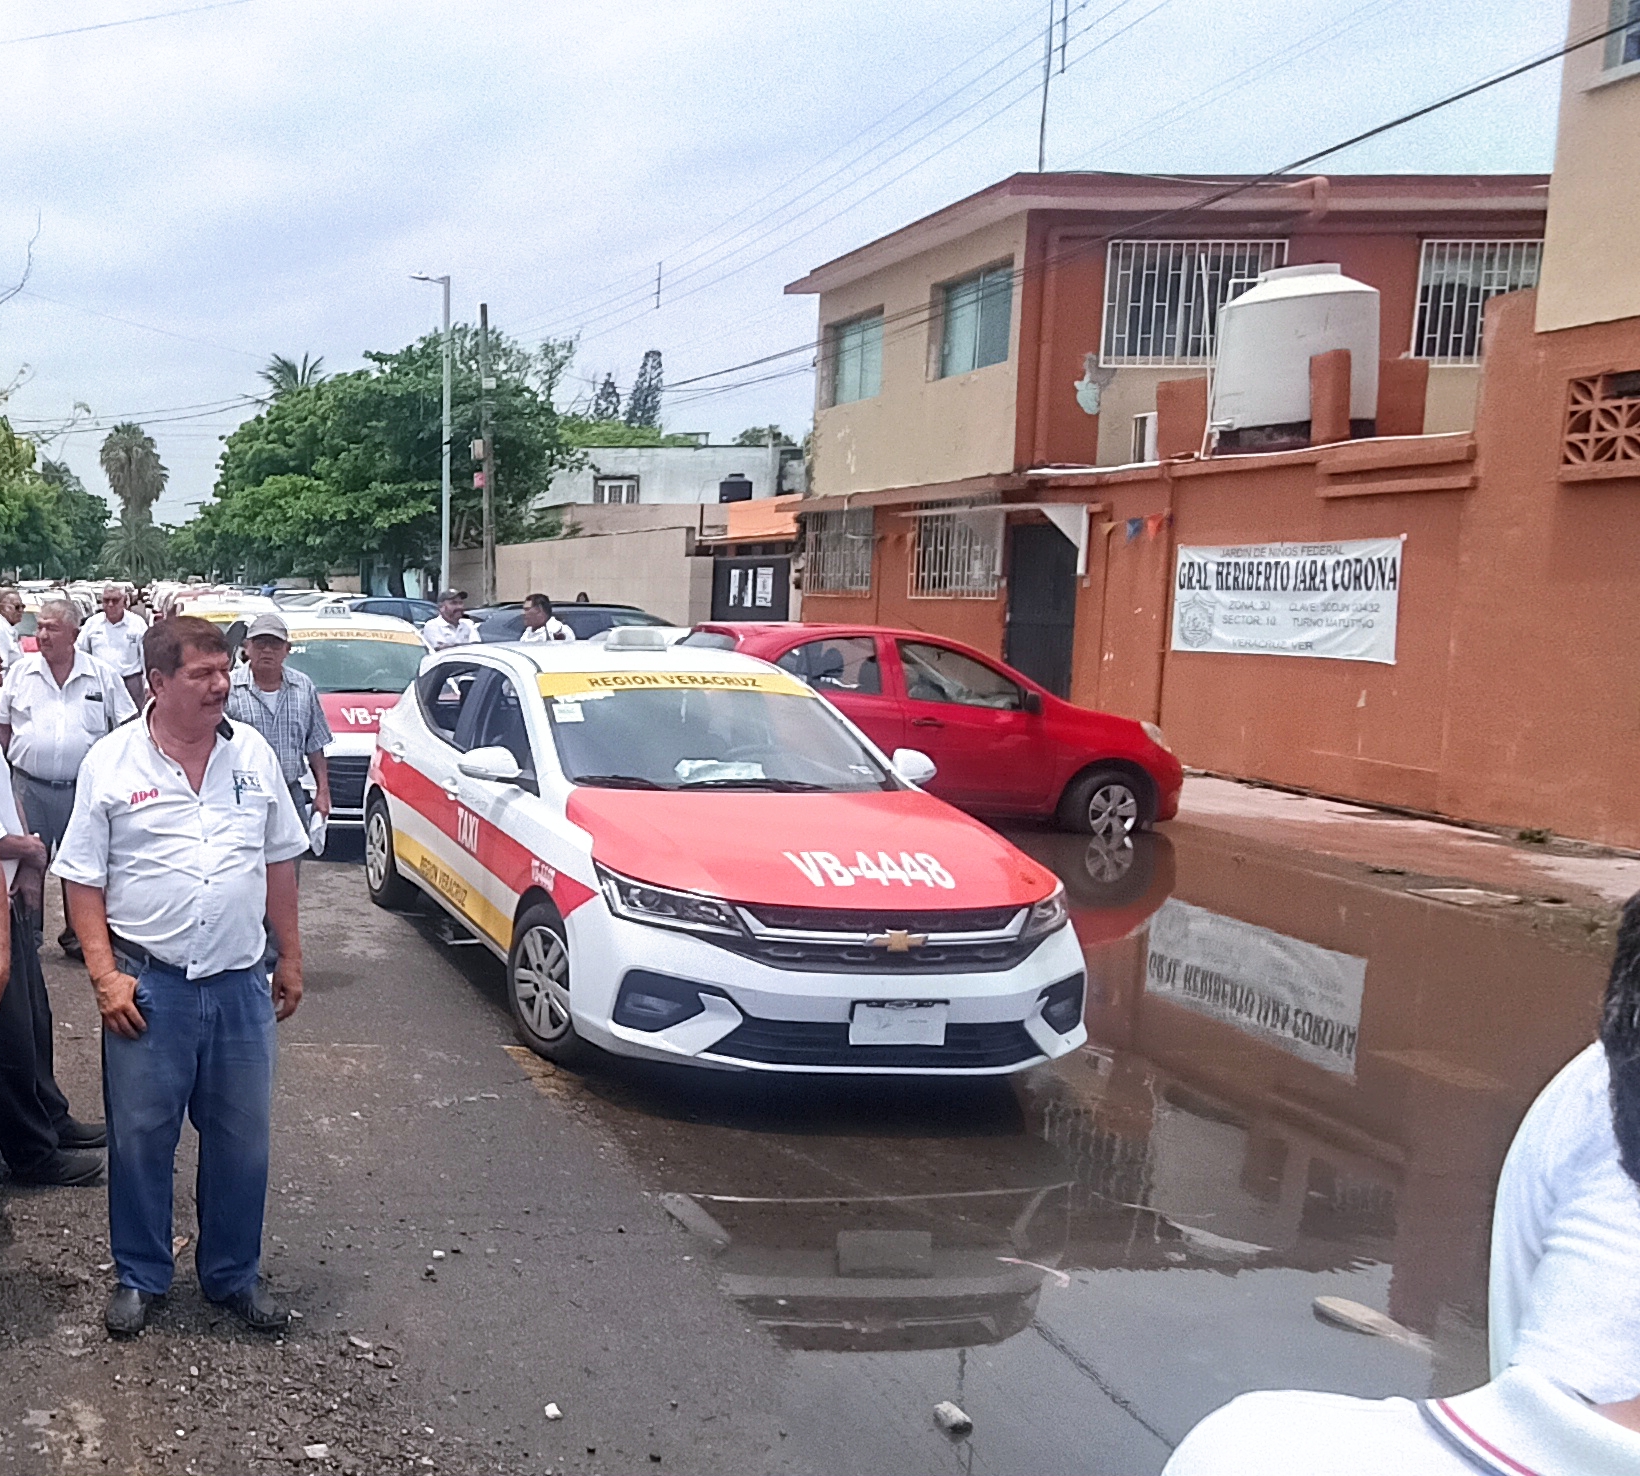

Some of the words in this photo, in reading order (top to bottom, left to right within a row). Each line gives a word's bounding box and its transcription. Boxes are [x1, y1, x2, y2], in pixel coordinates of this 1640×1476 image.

[1254, 547, 1267, 557] DE
[1300, 545, 1344, 556] FEDERAL
[1215, 560, 1290, 592] HERIBERTO
[1293, 558, 1328, 592] JARA
[1331, 556, 1398, 592] CORONA
[324, 606, 346, 614] TAXI
[331, 630, 394, 640] VERACRUZ
[662, 675, 762, 688] VERACRUZ
[130, 788, 159, 805] ADO
[457, 806, 479, 854] TAXI
[782, 851, 956, 889] VB-4448
